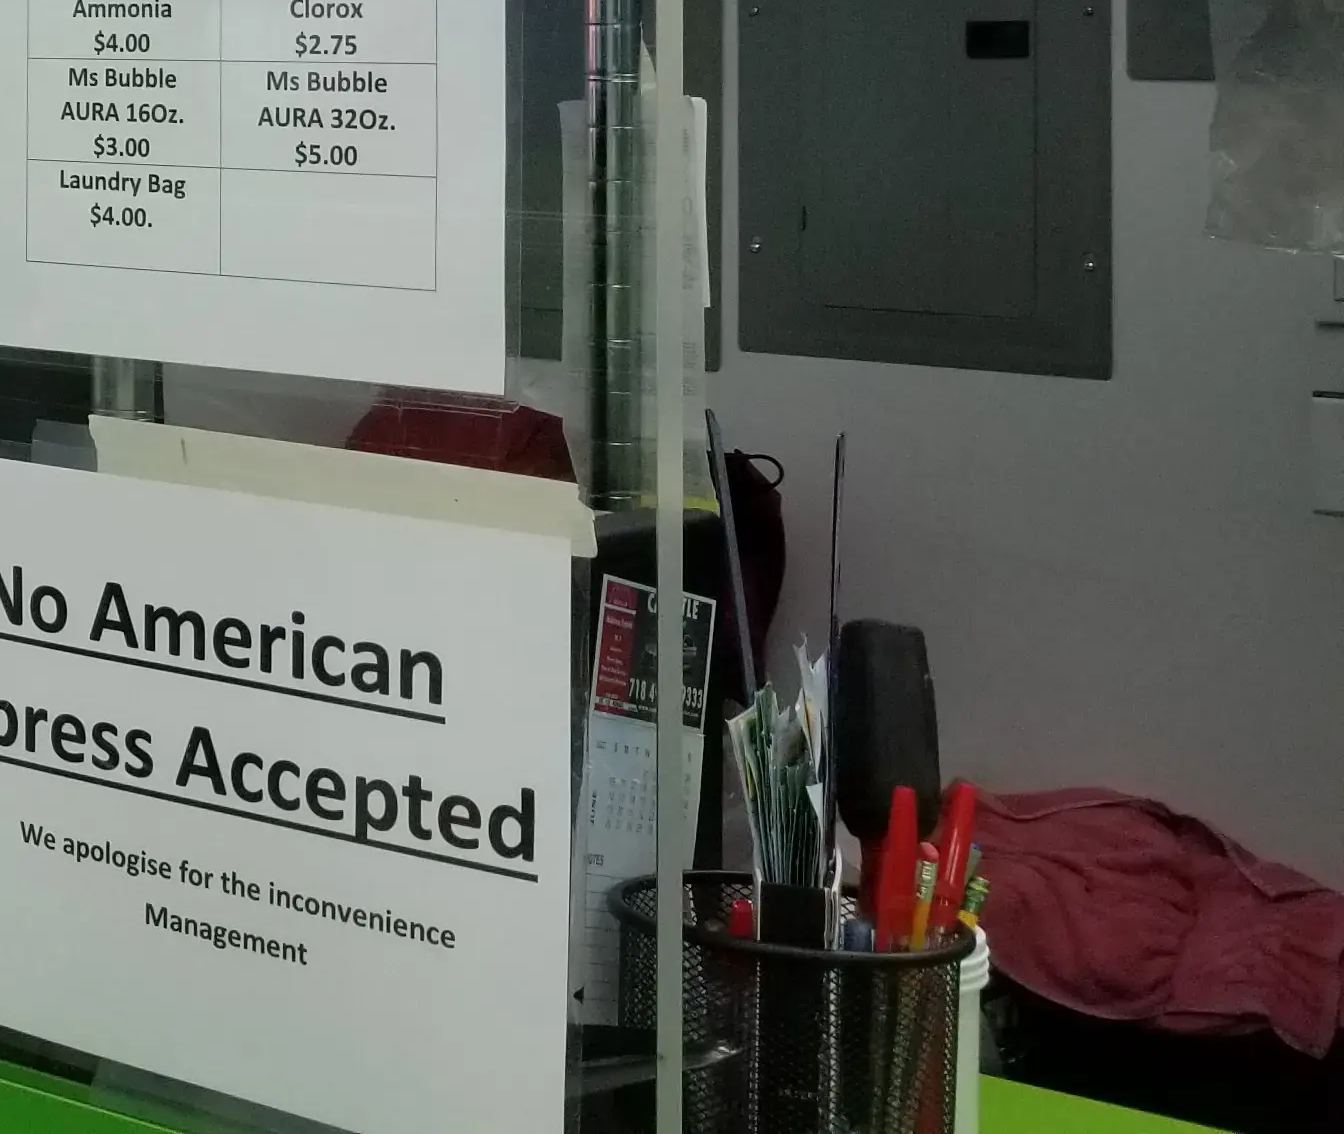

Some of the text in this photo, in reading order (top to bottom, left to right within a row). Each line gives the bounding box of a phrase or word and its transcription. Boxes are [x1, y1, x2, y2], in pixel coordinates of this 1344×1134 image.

[73, 0, 172, 18] Ammonia
[94, 32, 150, 54] $4.00
[294, 33, 357, 57] $2.75
[68, 68, 177, 89] Ms Bubble
[266, 71, 388, 94] Ms Bubble
[61, 102, 185, 125] AURA 16Oz.
[258, 107, 396, 131] AURA 32Oz.
[93, 135, 150, 158] $3.00
[294, 143, 358, 167] $5.00
[60, 171, 186, 199] Laundry Bag
[90, 203, 153, 227] $4.00.
[89, 581, 443, 706] American
[175, 725, 535, 863] Accepted
[19, 821, 456, 949] We apologise for the inconvenience
[144, 902, 309, 966] Management
